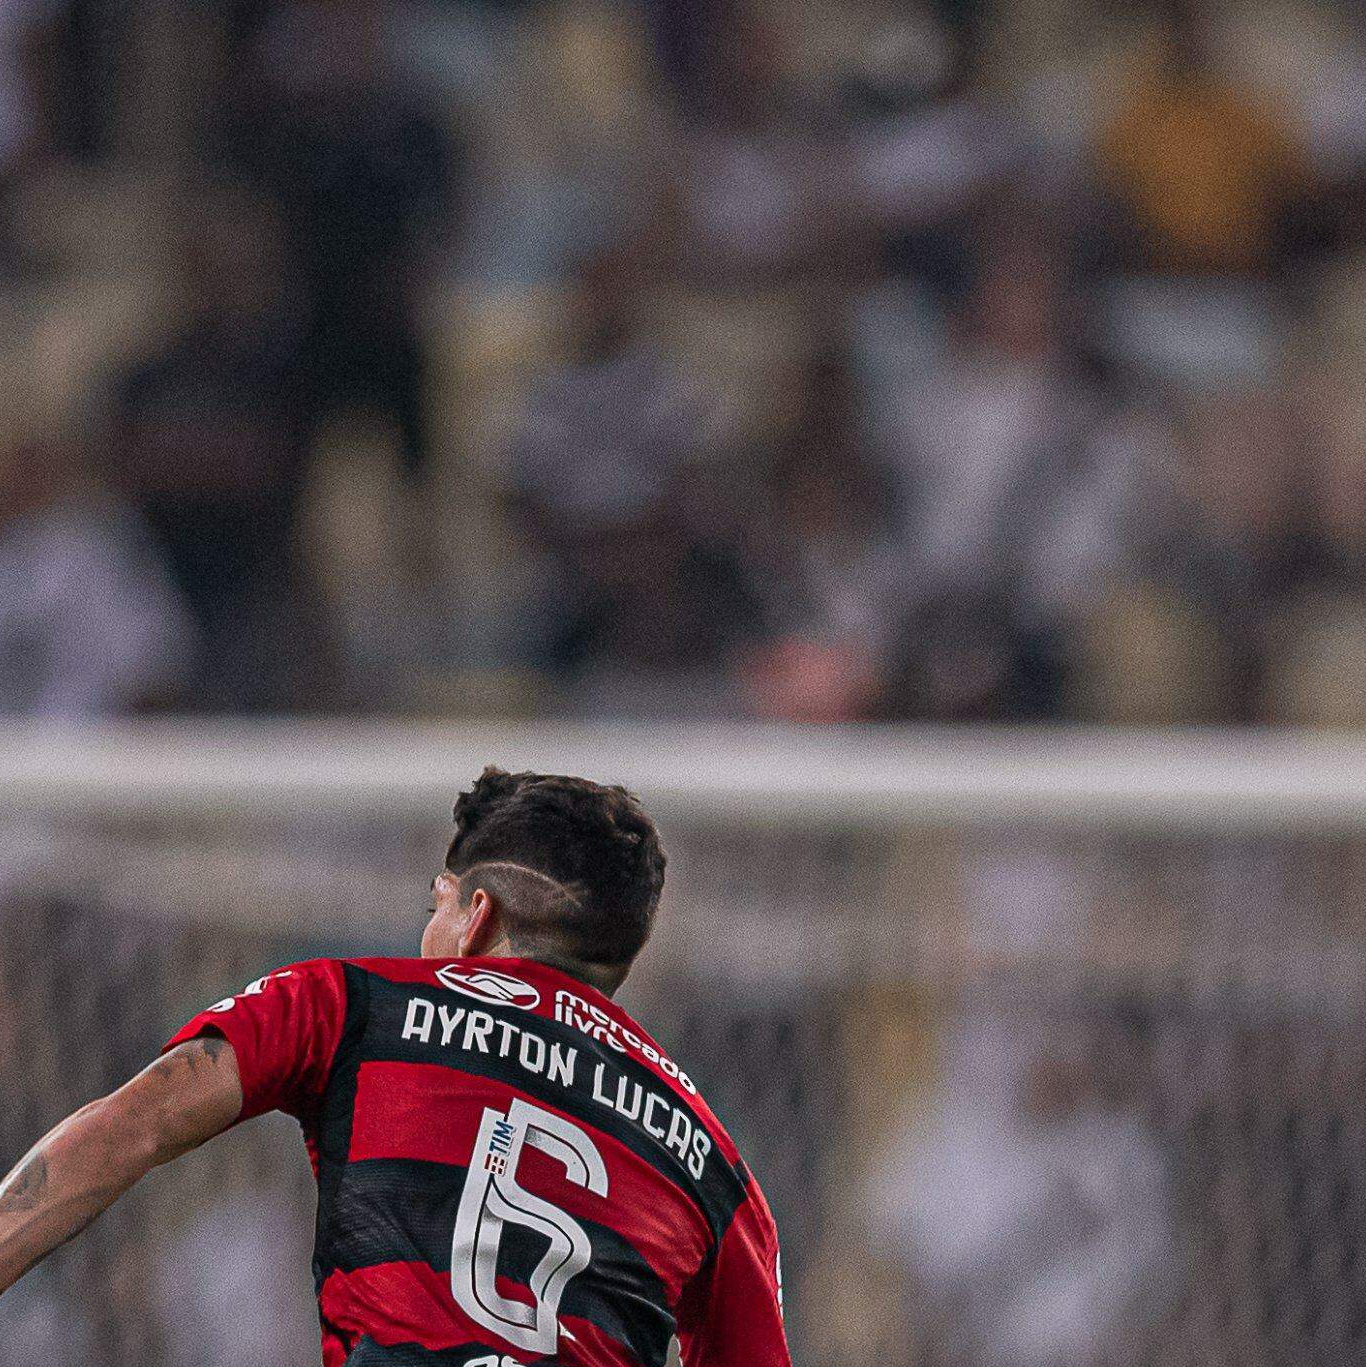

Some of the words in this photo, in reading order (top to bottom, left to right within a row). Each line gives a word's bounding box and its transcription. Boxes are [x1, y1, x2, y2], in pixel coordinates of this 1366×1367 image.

[555, 1000, 628, 1053] livre
[556, 990, 697, 1096] mercado
[401, 997, 578, 1087] AYRTON
[592, 1062, 712, 1180] LUCAS
[492, 1120, 514, 1158] TIM
[450, 1097, 609, 1355] 6
